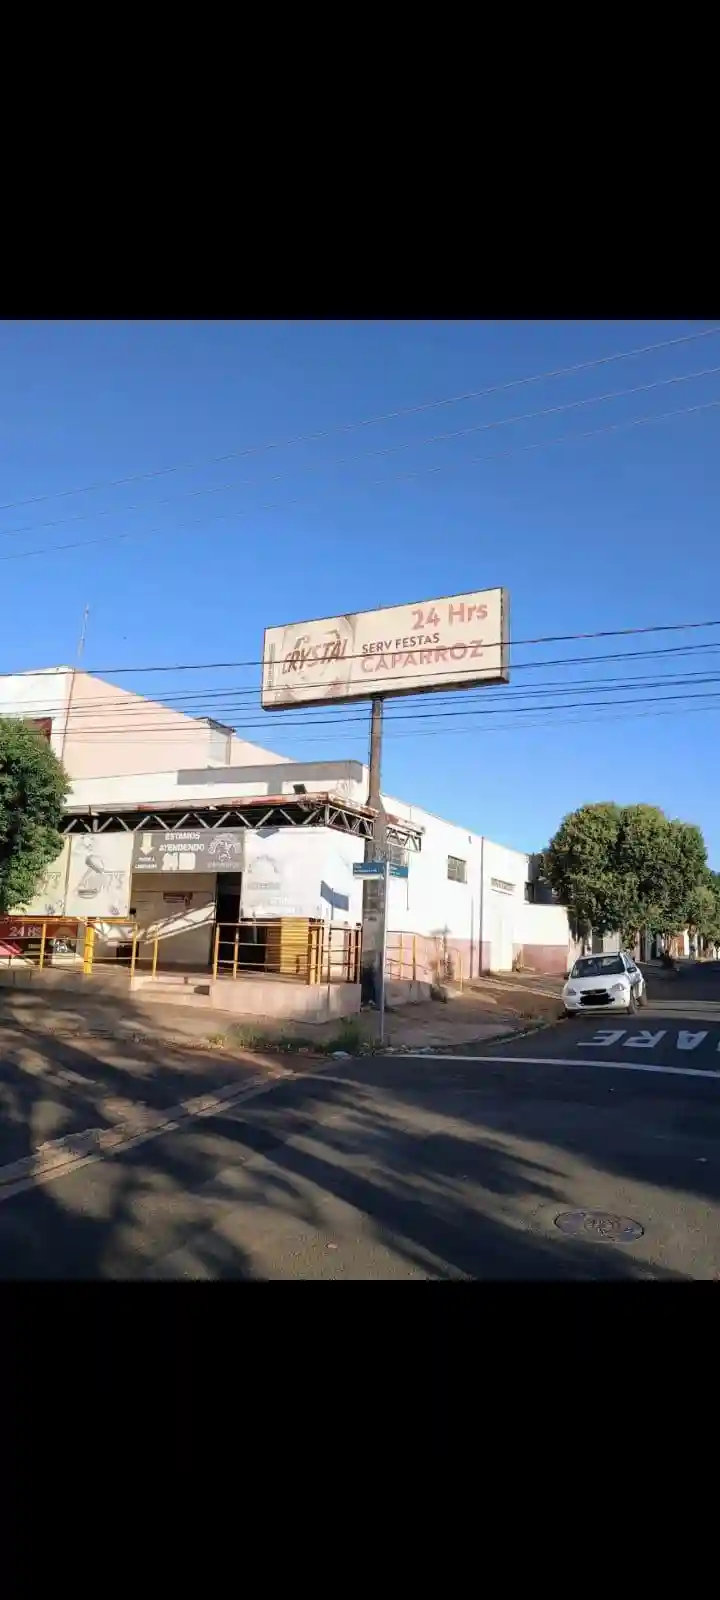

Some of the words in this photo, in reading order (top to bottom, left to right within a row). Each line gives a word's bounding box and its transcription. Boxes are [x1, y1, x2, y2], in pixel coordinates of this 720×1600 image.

[412, 607, 440, 630] 24
[448, 602, 488, 626] Hrs
[282, 638, 348, 674] CRYSTAL
[361, 639, 484, 673] CAPARROZ
[362, 639, 393, 653] SERV
[395, 633, 440, 649] FESTAS
[576, 1030, 720, 1052] ARE
